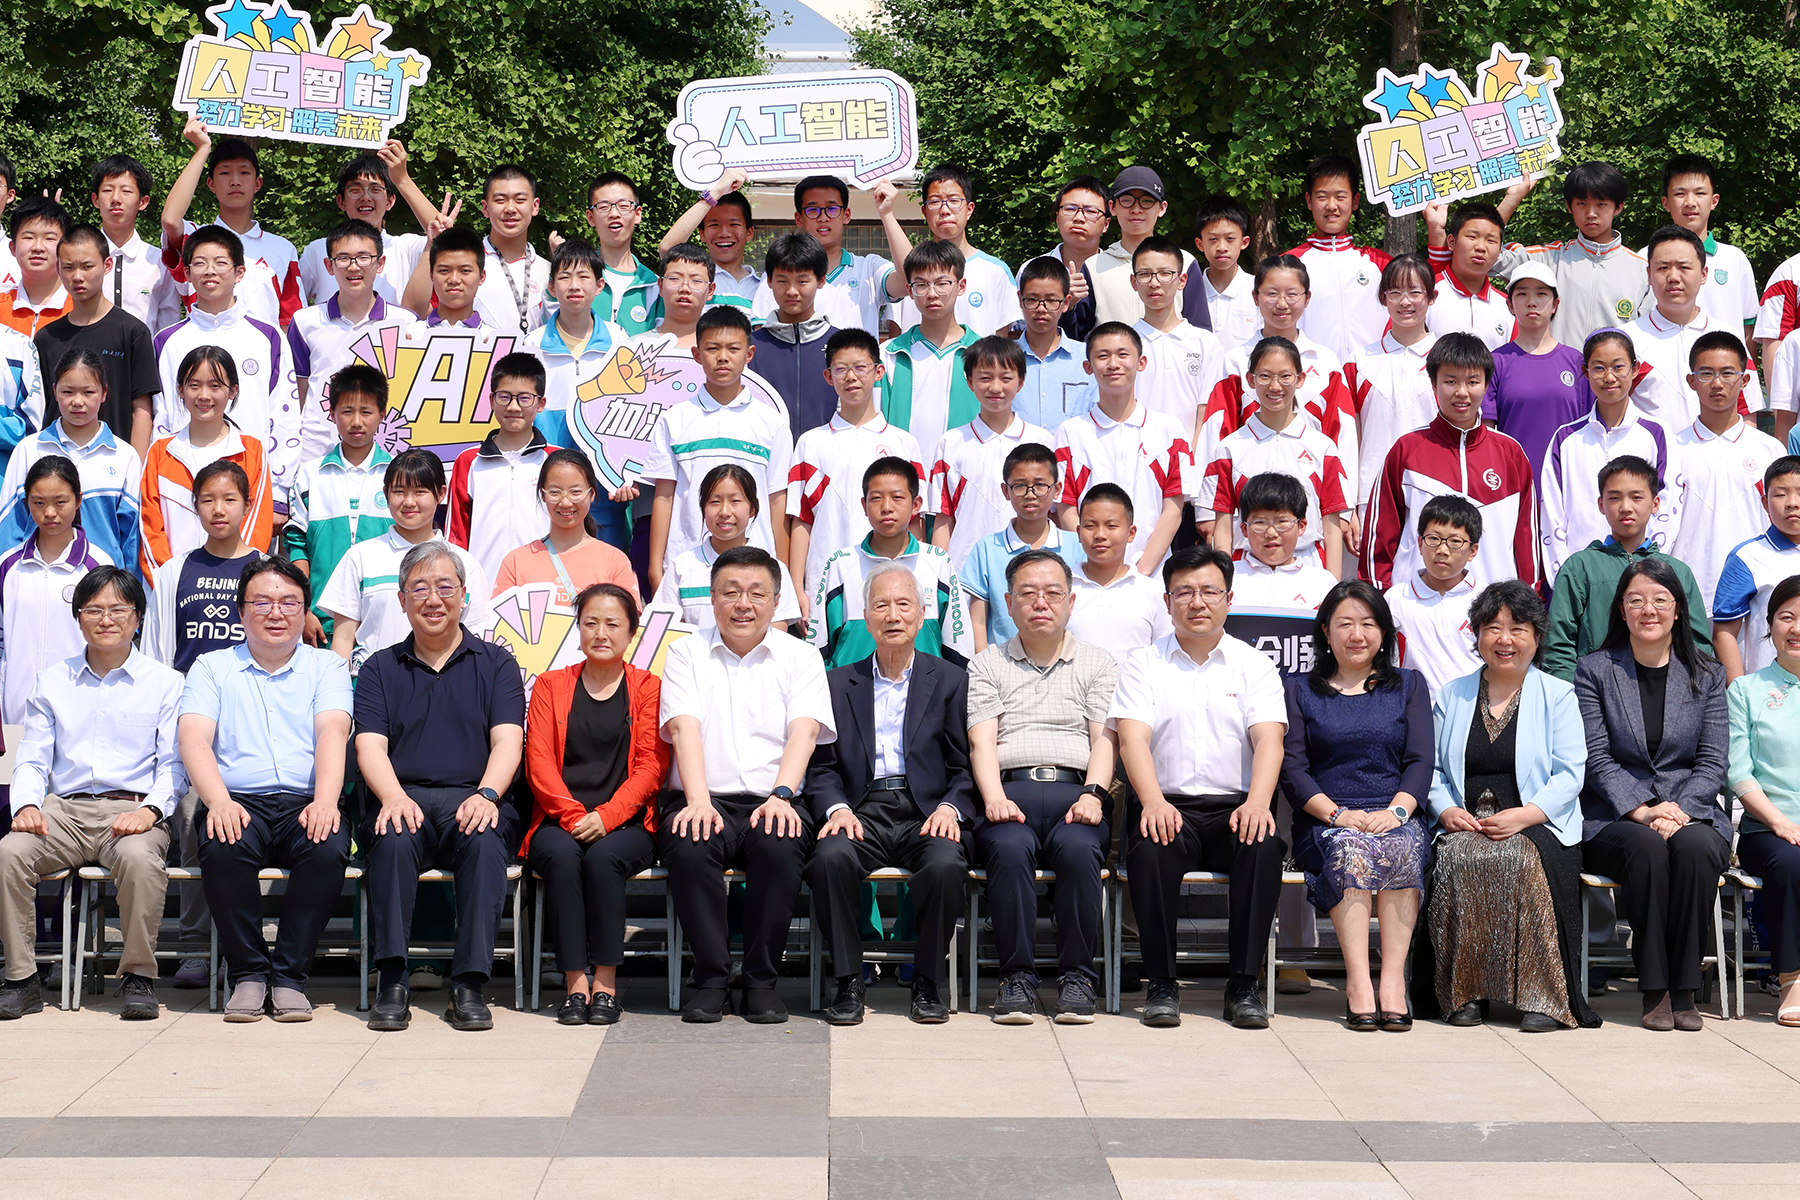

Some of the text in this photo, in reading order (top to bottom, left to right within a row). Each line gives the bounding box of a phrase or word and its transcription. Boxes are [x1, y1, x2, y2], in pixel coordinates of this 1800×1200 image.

[200, 57, 394, 110] 人工智能
[197, 99, 383, 142] 努力学习 照亮未来
[716, 98, 890, 148] 人工智能
[1387, 102, 1552, 177] 人工智能
[1389, 164, 1477, 210] 努力学习
[402, 335, 518, 424] AI
[179, 592, 215, 609] NATIONAL
[216, 592, 231, 601] DAY
